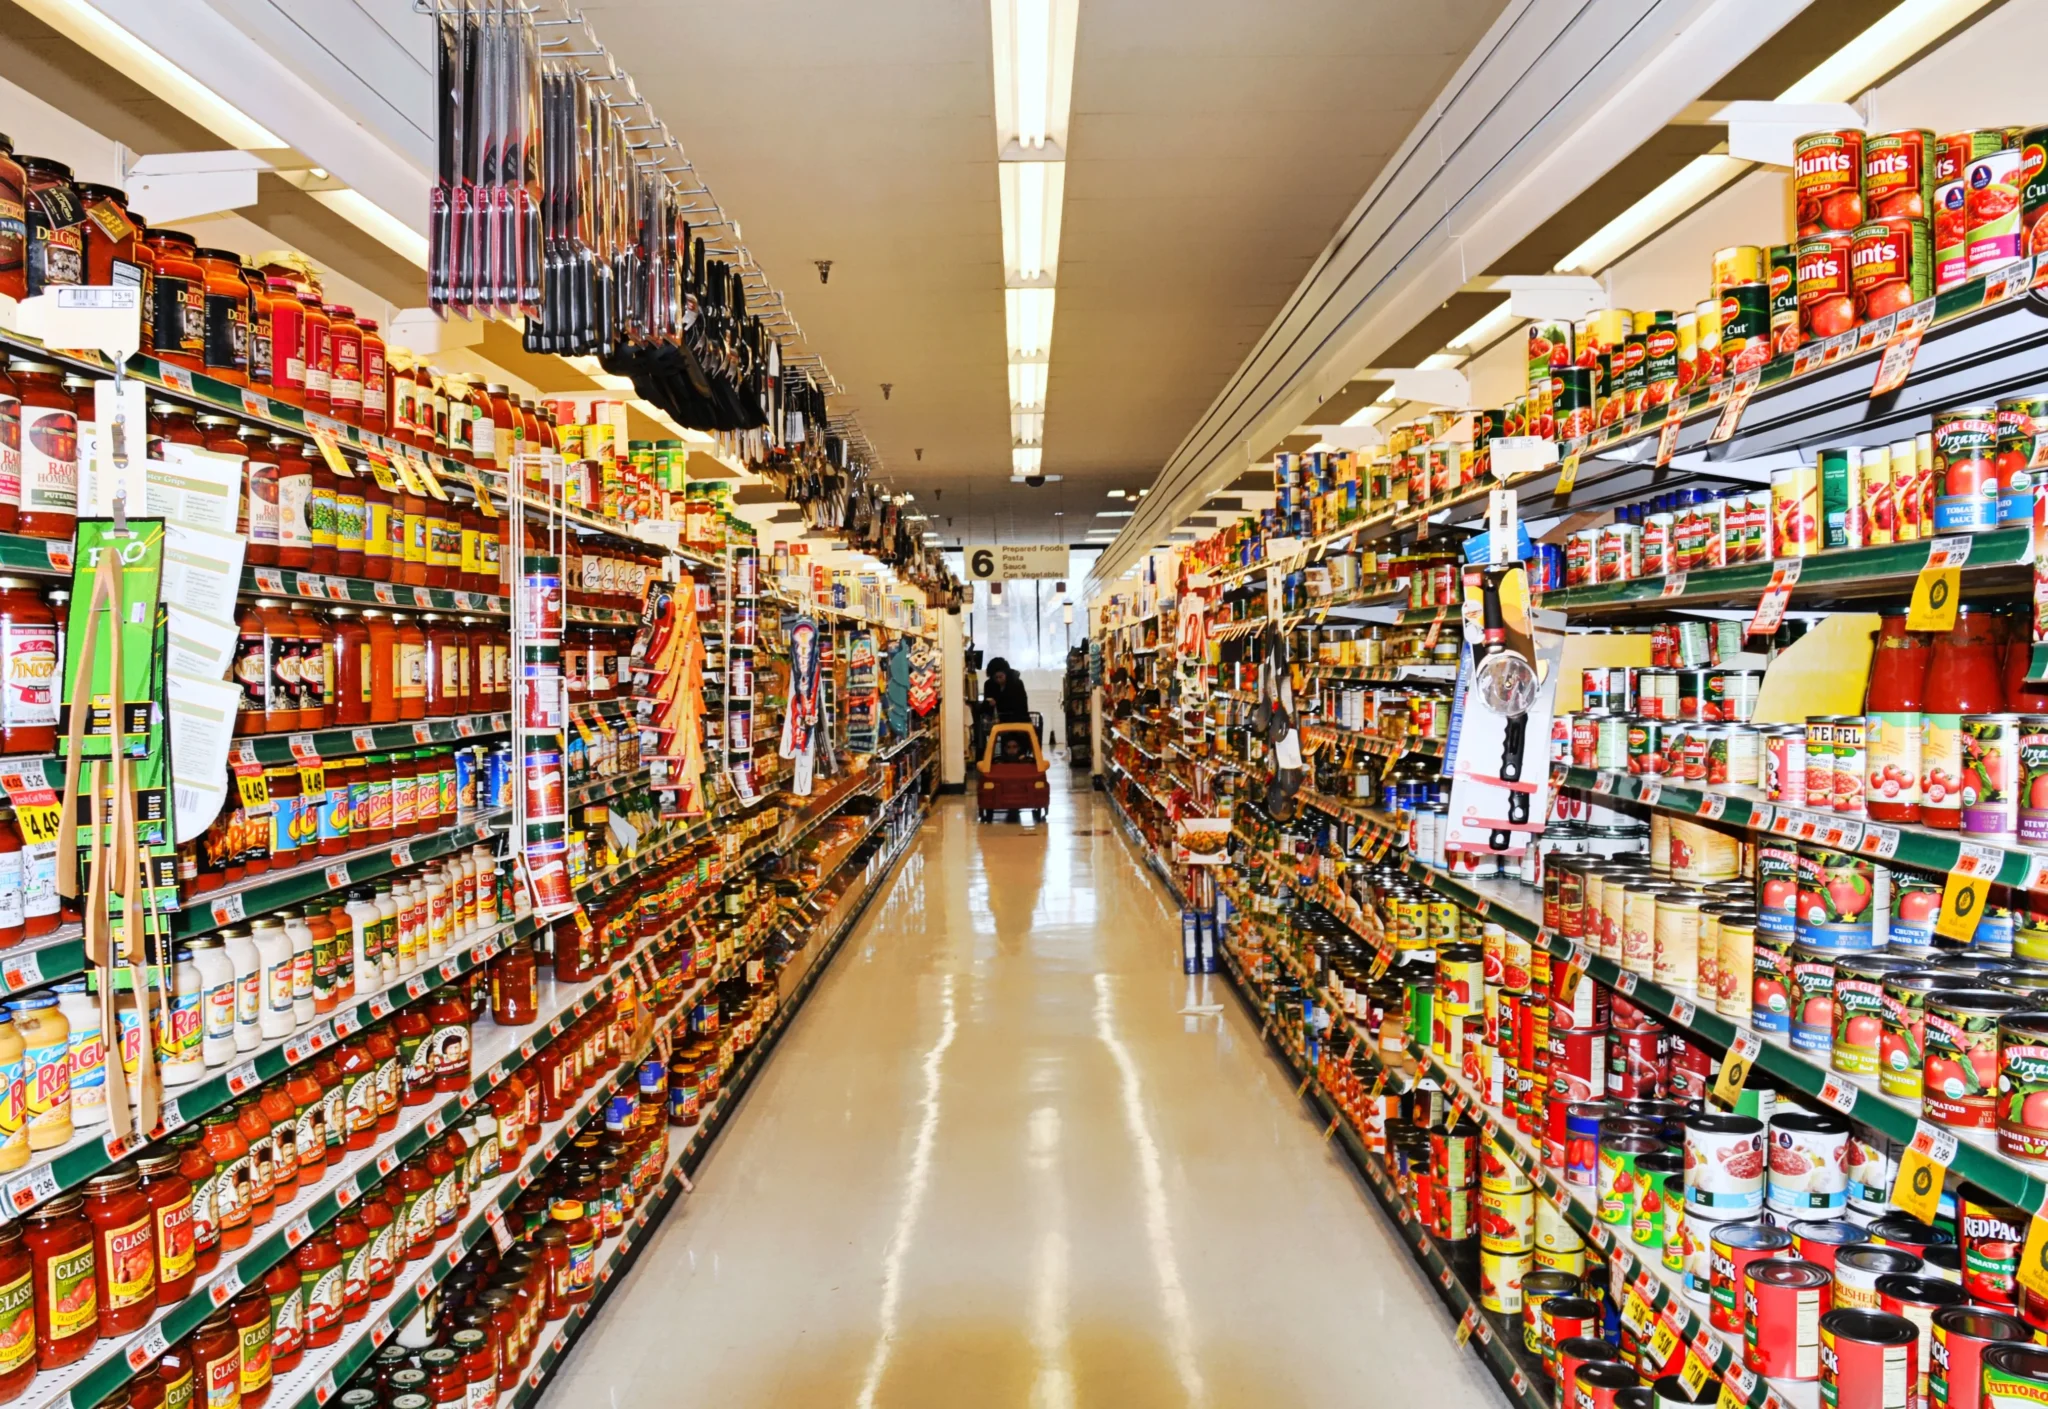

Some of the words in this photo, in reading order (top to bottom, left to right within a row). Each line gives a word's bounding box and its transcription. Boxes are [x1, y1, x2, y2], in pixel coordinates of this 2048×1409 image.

[1795, 152, 1851, 179] Hunt's
[1806, 184, 1832, 194] DICED
[2026, 183, 2048, 200] Cu
[1777, 296, 1798, 308] Cut
[1726, 323, 1747, 335] Cut
[1998, 411, 2026, 425] GLEN
[1962, 420, 1996, 435] GLEN
[1938, 431, 1991, 453] Organic
[1002, 545, 1037, 553] Prepared
[1040, 544, 1064, 552] Foods
[971, 549, 995, 578] 6
[1002, 571, 1018, 579] Can
[1021, 571, 1064, 580] Vegetables
[15, 794, 29, 804] Fresh
[39, 792, 52, 802] Price
[1894, 928, 1926, 937] CHUNKY
[1932, 1019, 1958, 1038] GLEN
[1798, 1031, 1829, 1042] CHUNKY
[1926, 1096, 1966, 1114] TOMATOES
[1931, 1108, 1947, 1120] Basil
[1933, 1145, 1950, 1162] 2.99
